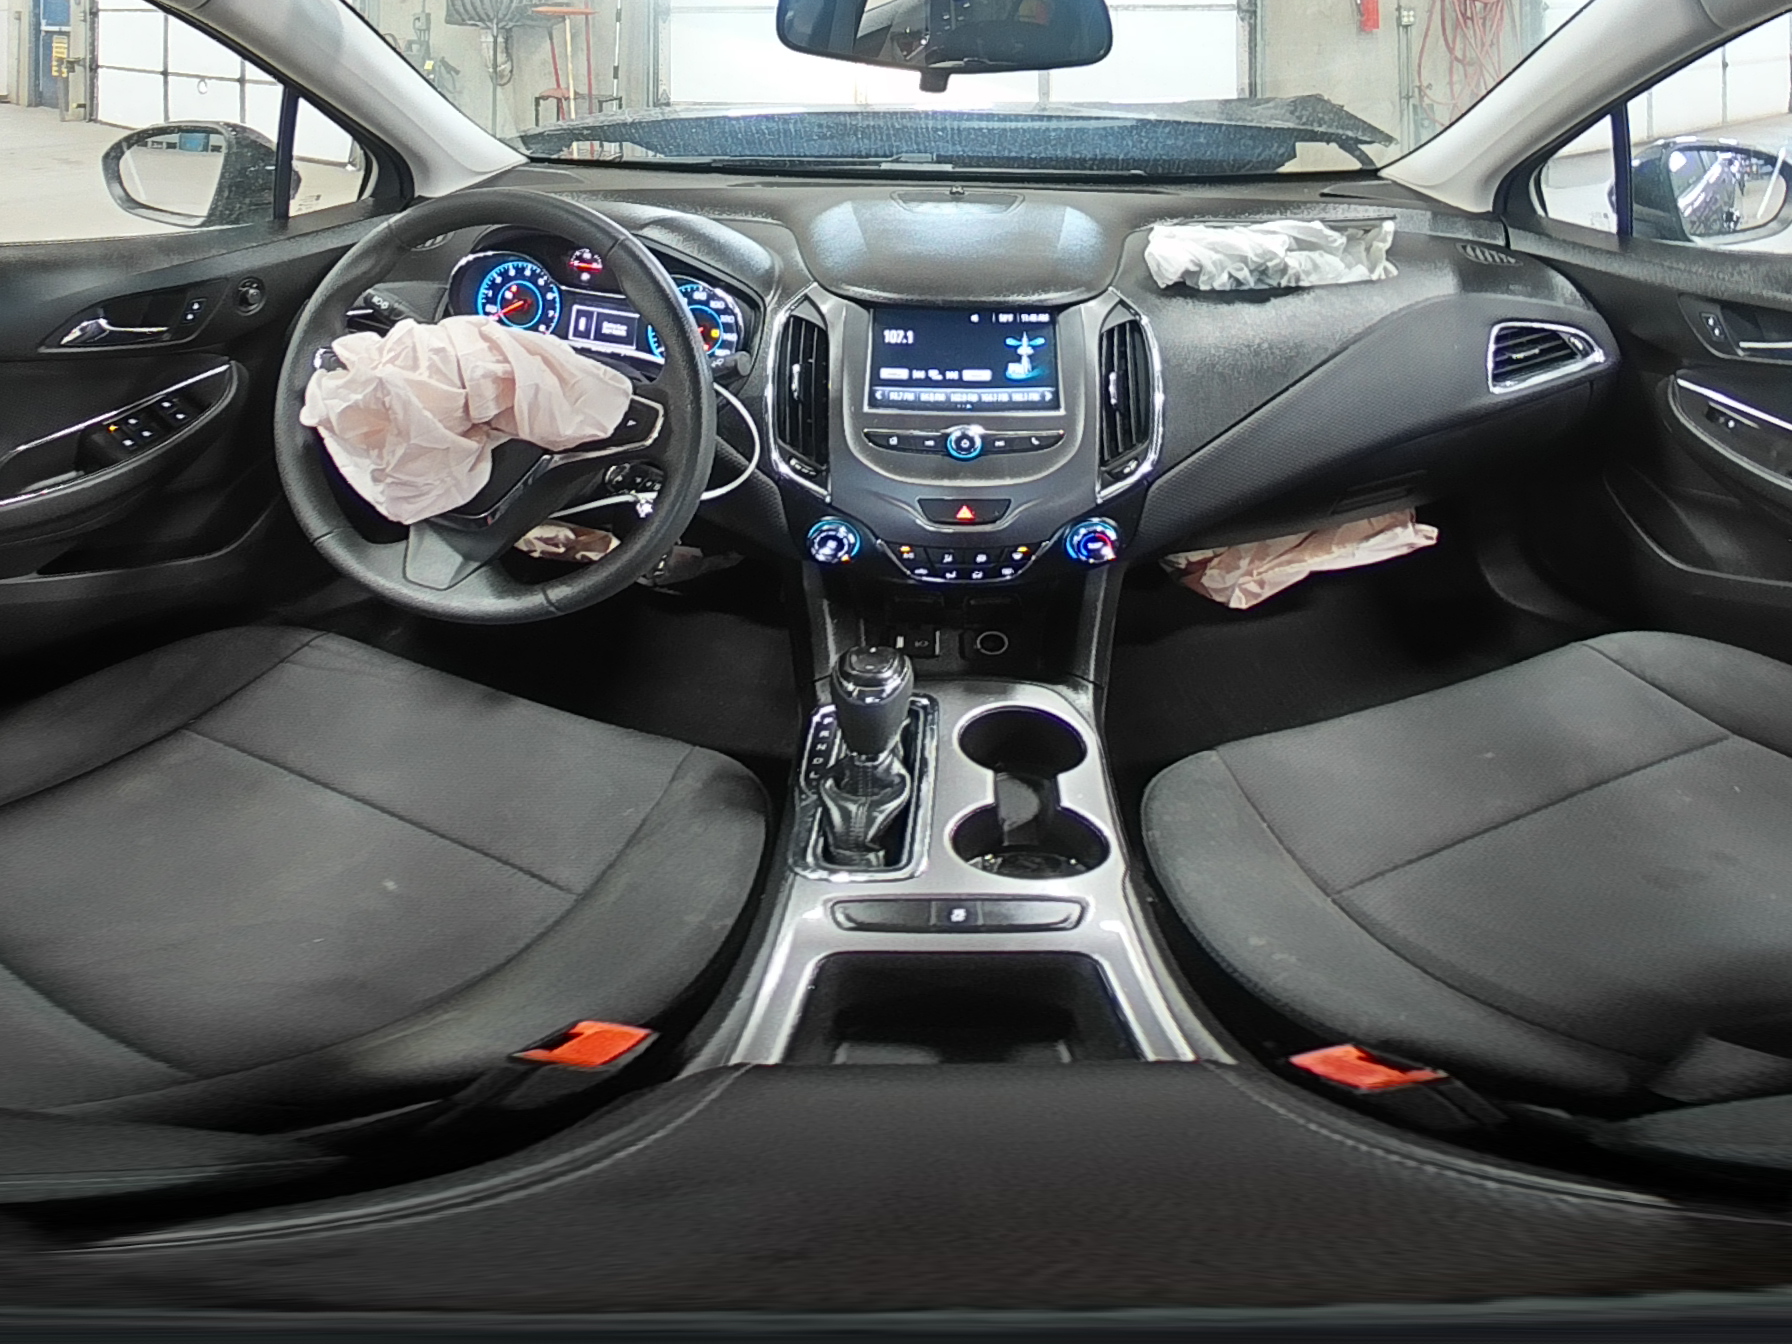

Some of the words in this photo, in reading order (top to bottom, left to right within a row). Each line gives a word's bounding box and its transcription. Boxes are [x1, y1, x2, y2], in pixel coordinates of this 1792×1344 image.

[710, 300, 725, 309] 100
[720, 315, 735, 324] 120
[883, 329, 914, 344] 107.1
[816, 742, 827, 751] N
[812, 757, 824, 765] D
[809, 771, 820, 779] L
